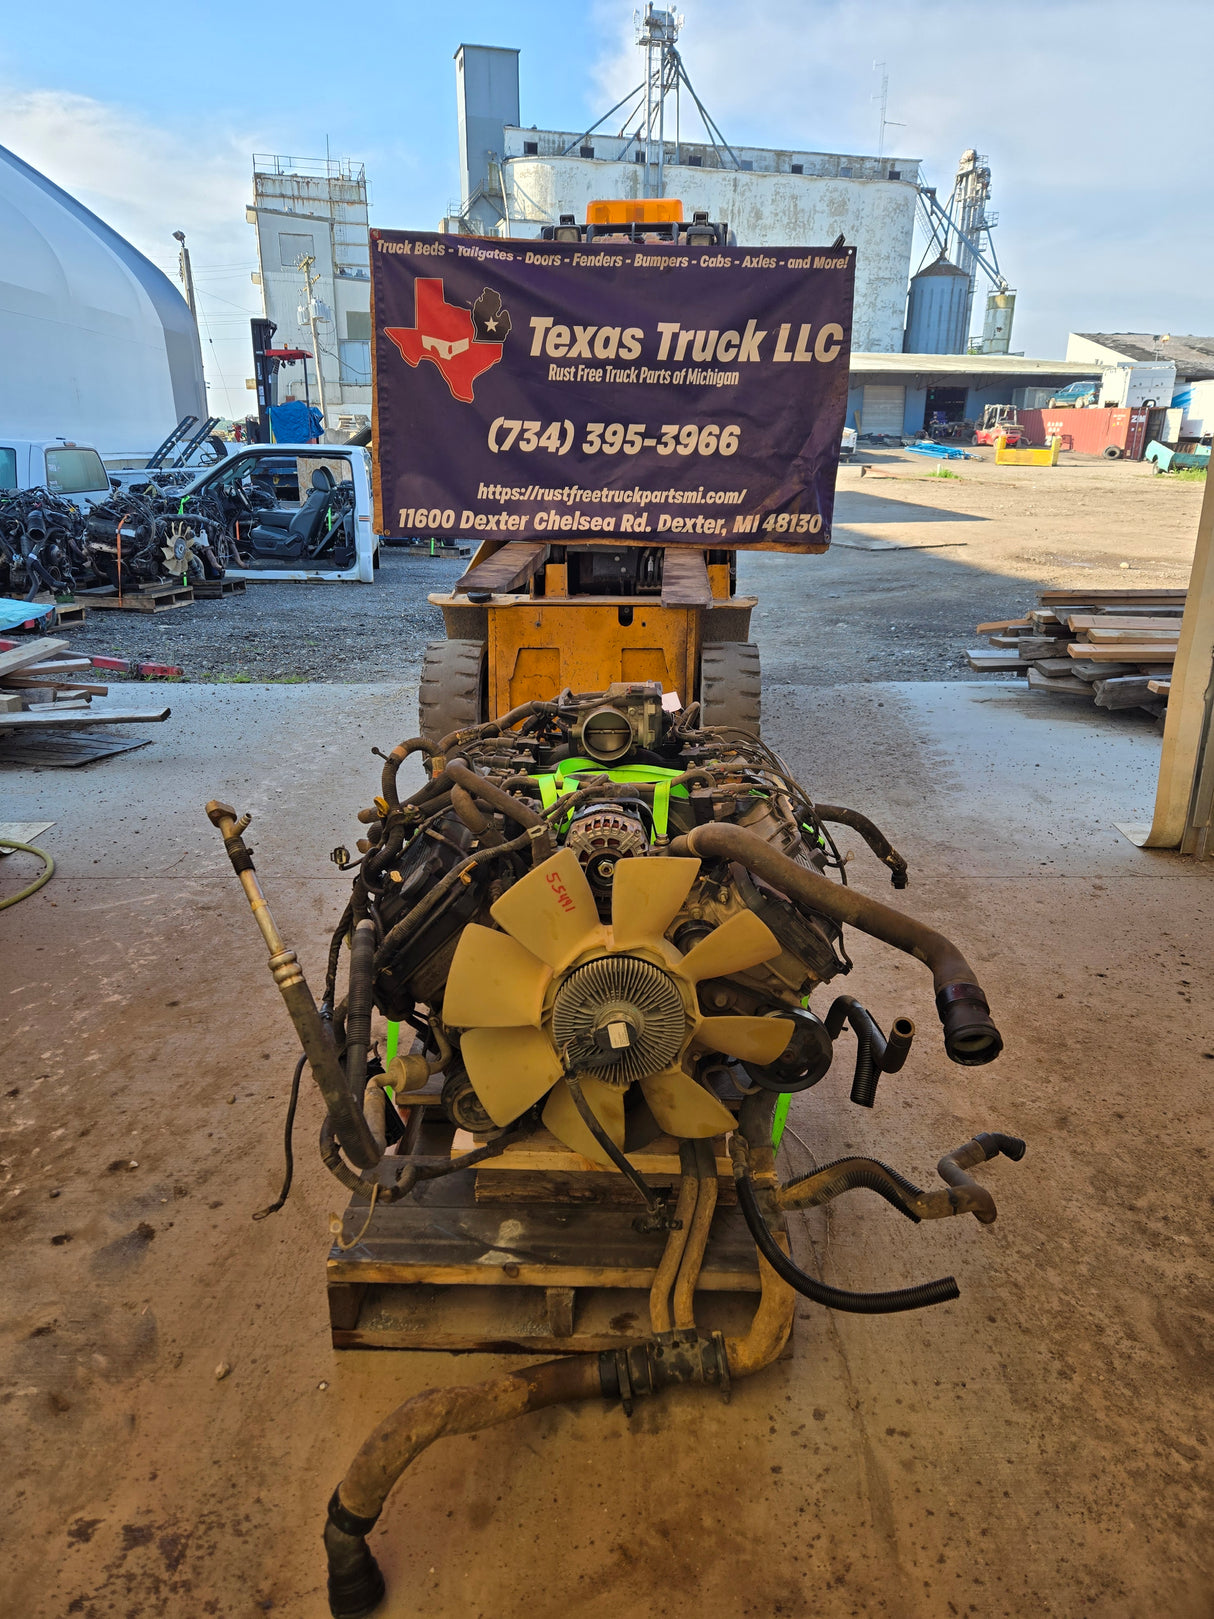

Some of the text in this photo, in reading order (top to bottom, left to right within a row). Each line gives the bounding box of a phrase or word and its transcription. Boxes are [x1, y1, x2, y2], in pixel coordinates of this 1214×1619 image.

[377, 240, 412, 255] Truck
[414, 241, 445, 256] Beds
[458, 245, 514, 261] Tailgates
[525, 252, 561, 266] Doors
[572, 252, 623, 267] Fenders
[634, 253, 689, 270] Bumpers
[700, 254, 732, 268] Cabs
[742, 254, 777, 268] Axles
[787, 256, 811, 269] and
[813, 256, 849, 269] More!
[529, 316, 844, 363] Texas Truck LLC
[548, 363, 739, 388] Rust Free Truck Parts of Michigan
[488, 416, 741, 456] (734) 395-3966
[477, 482, 748, 507] https://rustfreetruckpartsmi.com/
[399, 508, 823, 537] 11600 Dexter Chelsea Rd. Dexter, MI 48130
